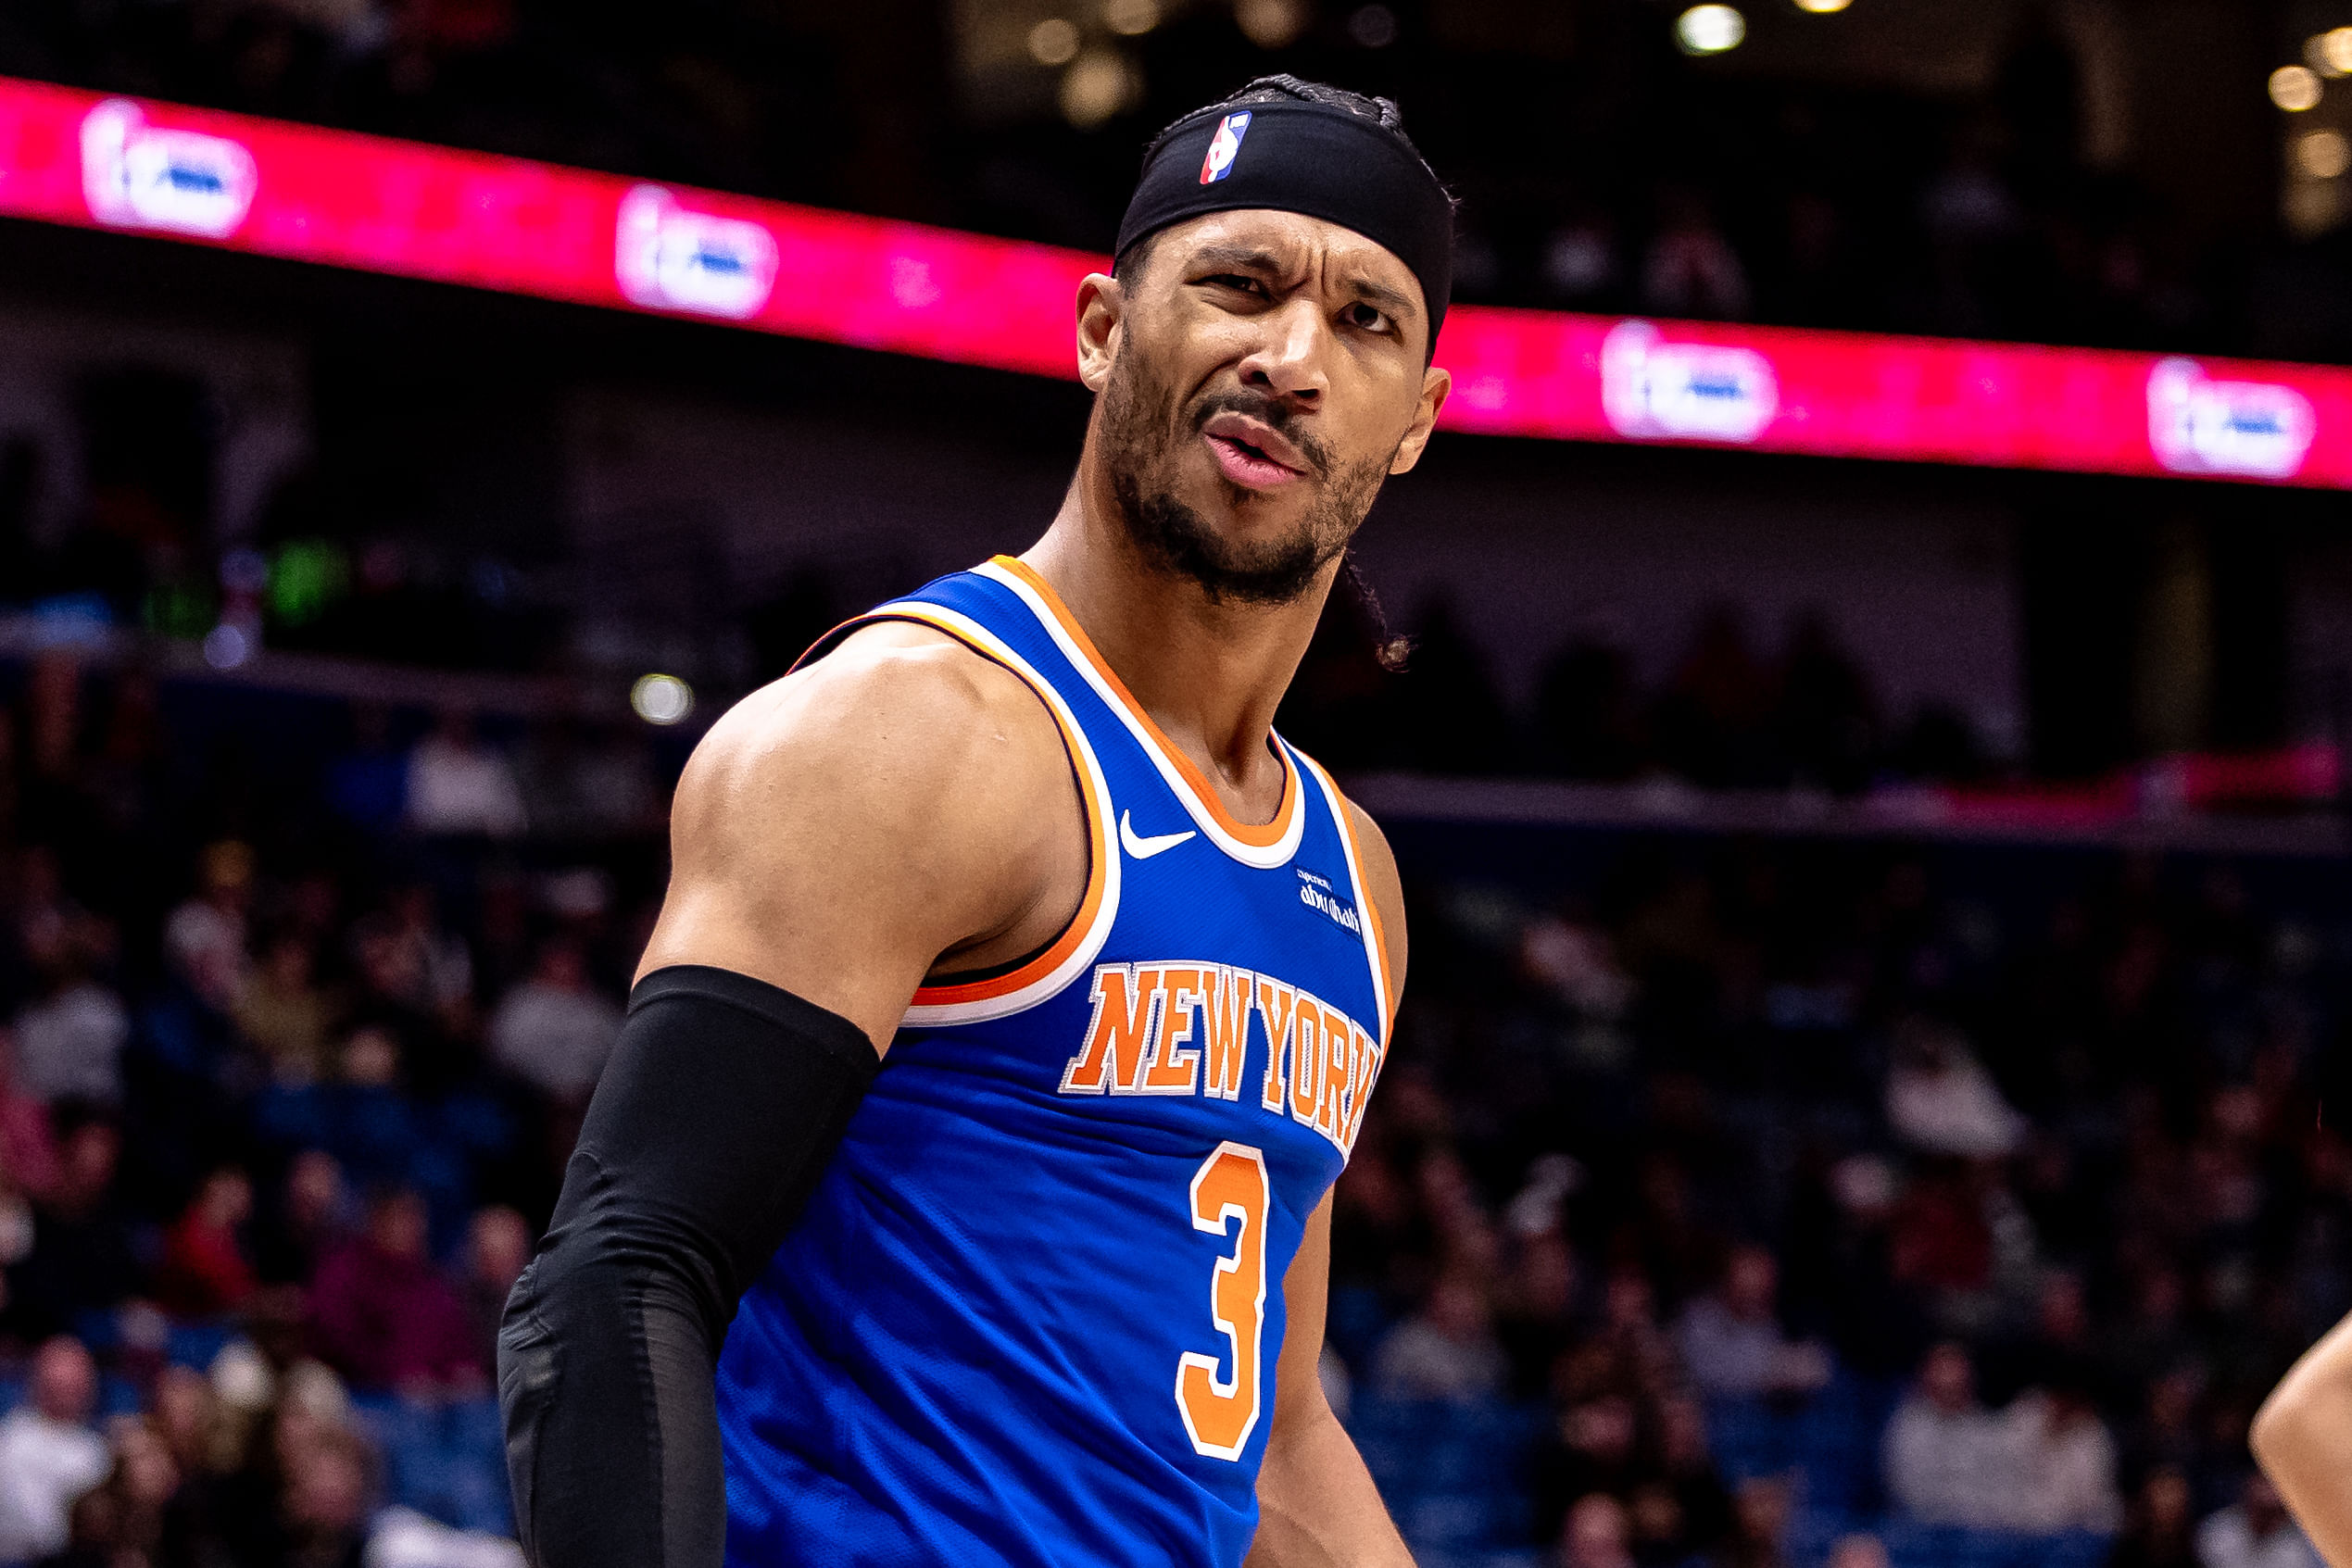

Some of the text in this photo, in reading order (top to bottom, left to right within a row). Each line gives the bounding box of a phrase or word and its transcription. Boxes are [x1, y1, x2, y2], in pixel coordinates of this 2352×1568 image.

[1058, 960, 1382, 1169] NEW YORK
[1175, 1140, 1270, 1462] 3
